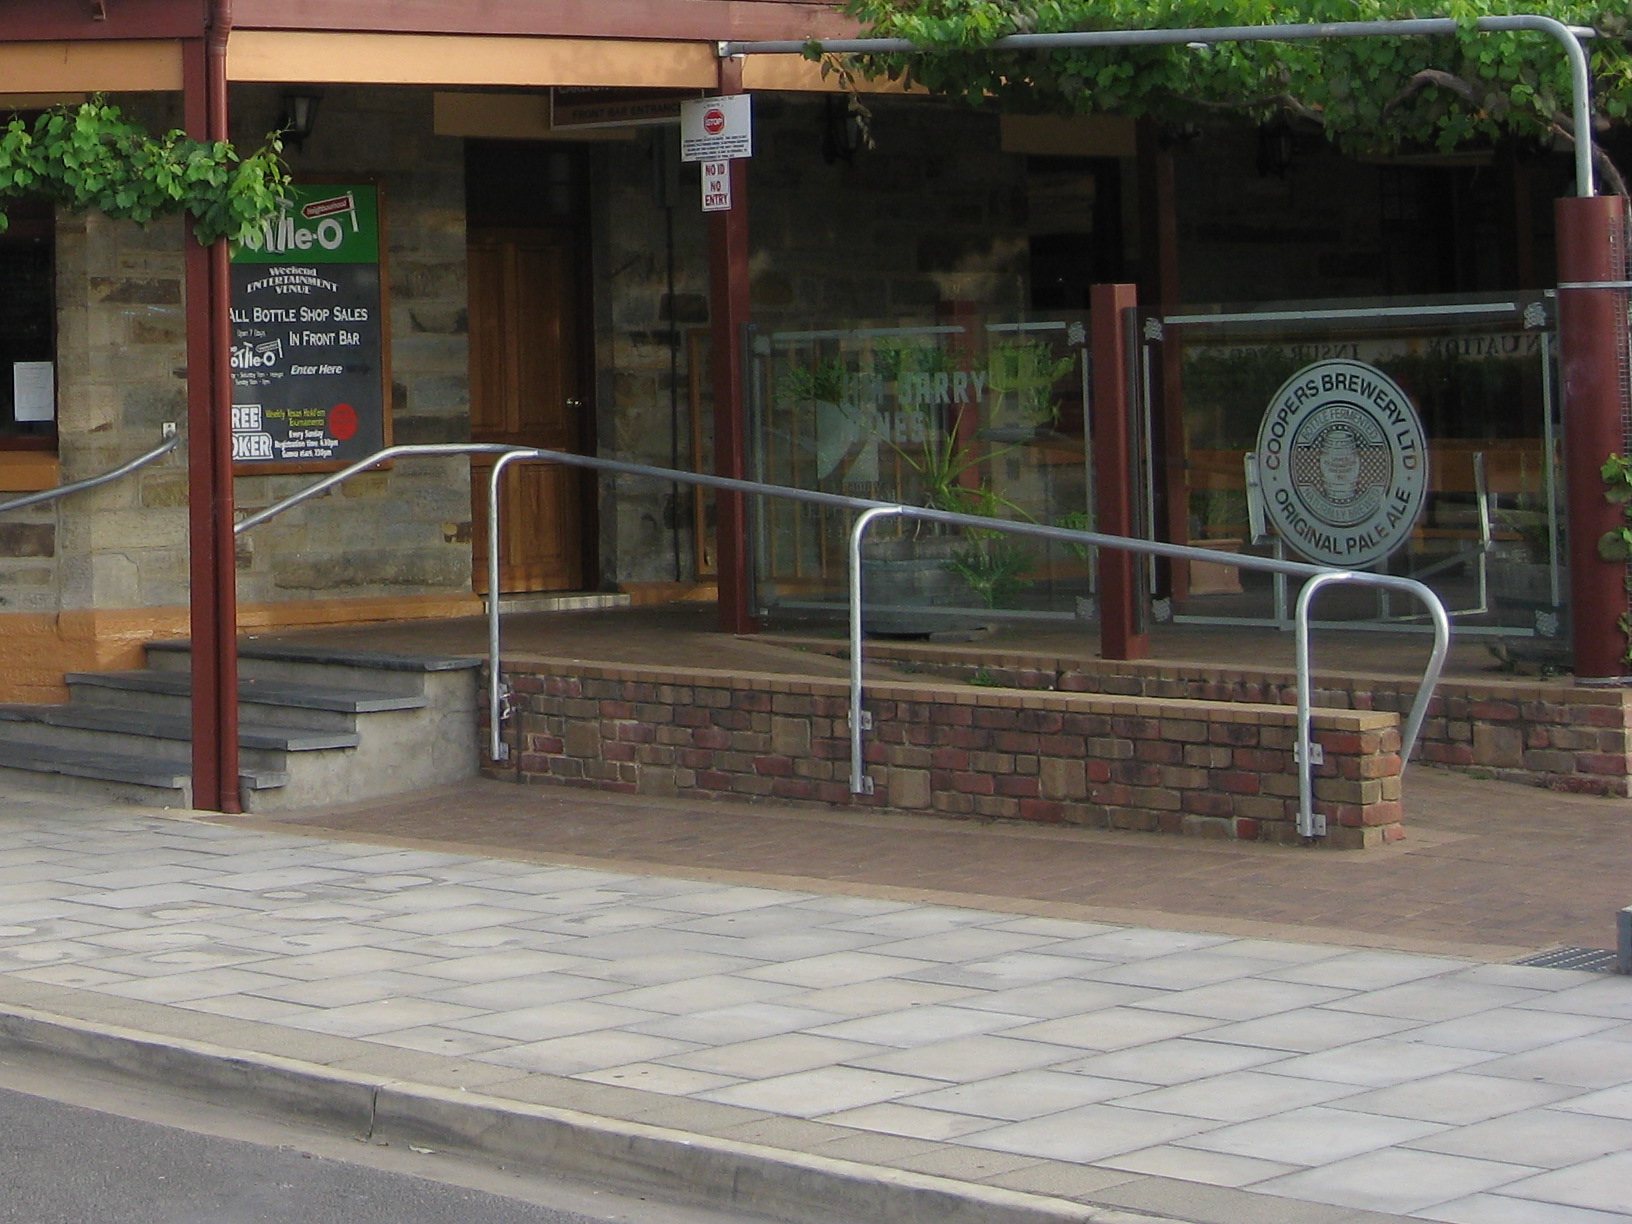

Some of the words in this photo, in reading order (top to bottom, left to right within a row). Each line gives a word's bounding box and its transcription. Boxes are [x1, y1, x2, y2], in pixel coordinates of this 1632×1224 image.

[630, 103, 681, 117] ENTRANC
[705, 164, 716, 176] NO
[717, 163, 725, 175] ID
[710, 180, 721, 192] NO
[705, 194, 728, 206] ENTRY
[269, 265, 317, 277] Weekend
[246, 275, 340, 294] ENTERTAINMENT
[275, 284, 312, 295] VENUE
[230, 307, 250, 323] ALL
[253, 306, 297, 323] BOTTLE
[300, 306, 330, 323] SHOP
[333, 306, 368, 322] SALES
[289, 330, 301, 346] IN
[302, 330, 338, 346] FRONT
[339, 330, 361, 346] BAR
[290, 364, 318, 376] Enter
[319, 364, 343, 375] Here
[897, 371, 988, 404] BARRY
[232, 406, 259, 428] REE
[1266, 379, 1319, 470] COOPERS
[1321, 372, 1406, 428] BREWERY
[1397, 430, 1417, 471] LTD
[1274, 488, 1342, 555] ORIGINAL
[1346, 523, 1390, 555] PALE
[1389, 486, 1411, 530] ALE
